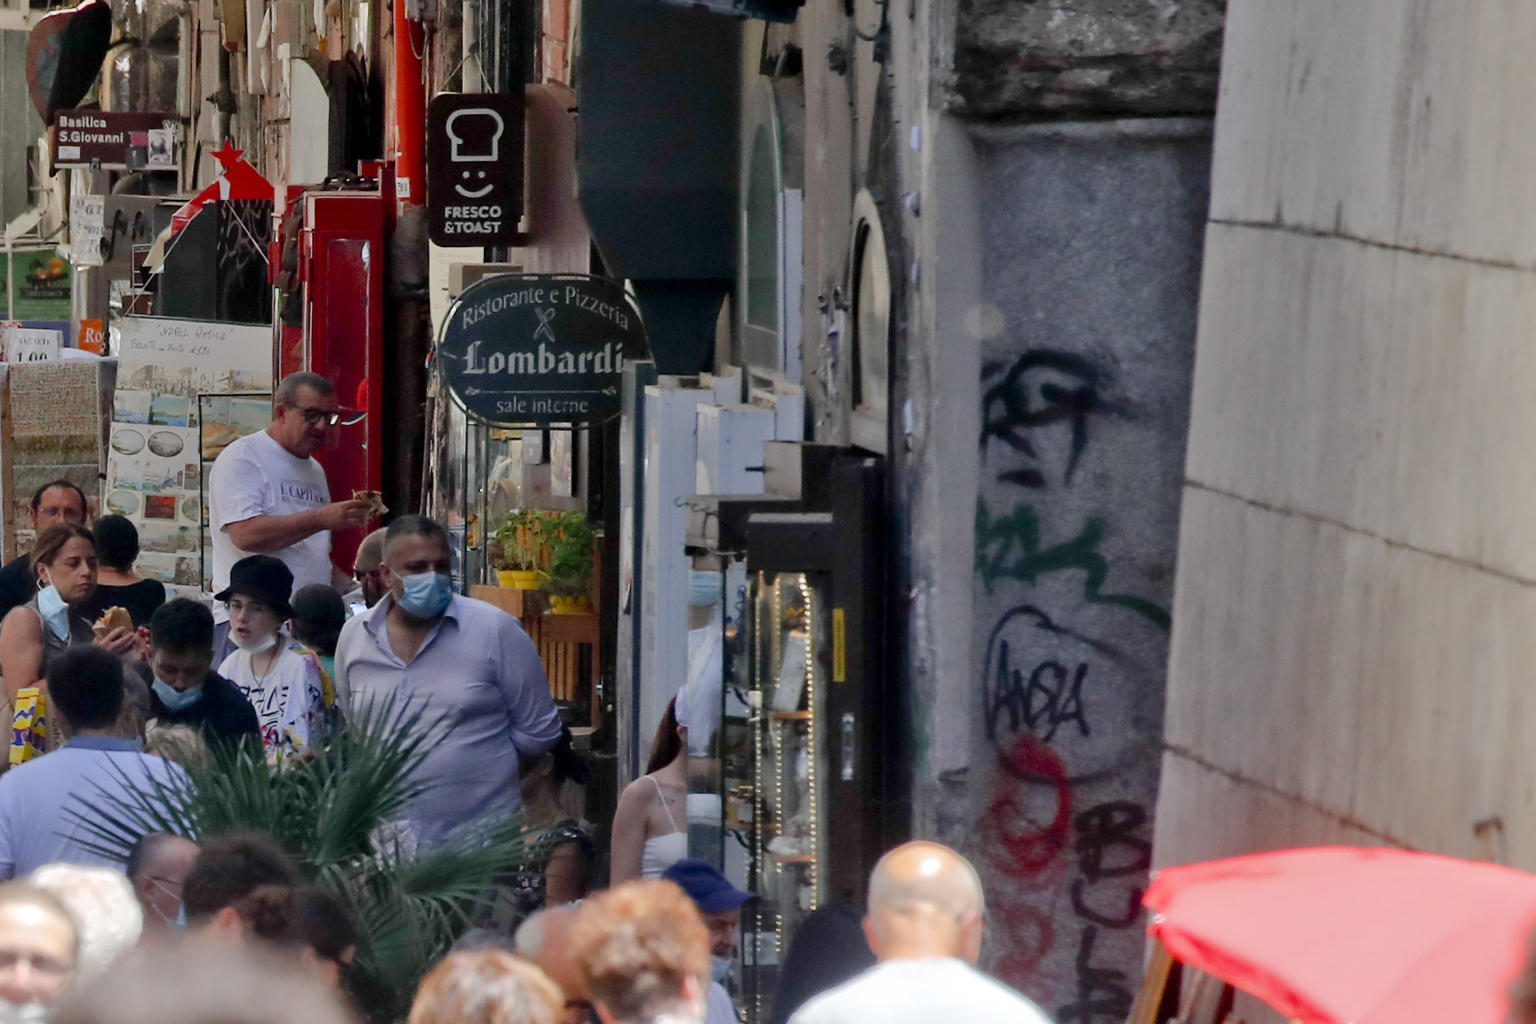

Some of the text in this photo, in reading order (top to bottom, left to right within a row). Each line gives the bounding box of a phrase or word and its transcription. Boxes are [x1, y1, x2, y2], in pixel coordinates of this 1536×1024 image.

[59, 116, 107, 128] Basilica
[59, 131, 124, 143] S.Giovanni
[444, 206, 502, 218] FRESCO
[444, 221, 502, 233] &TOAST
[462, 286, 629, 330] Ristorante e Pizzeria
[462, 340, 624, 375] Lombardi
[496, 396, 589, 413] sale interne
